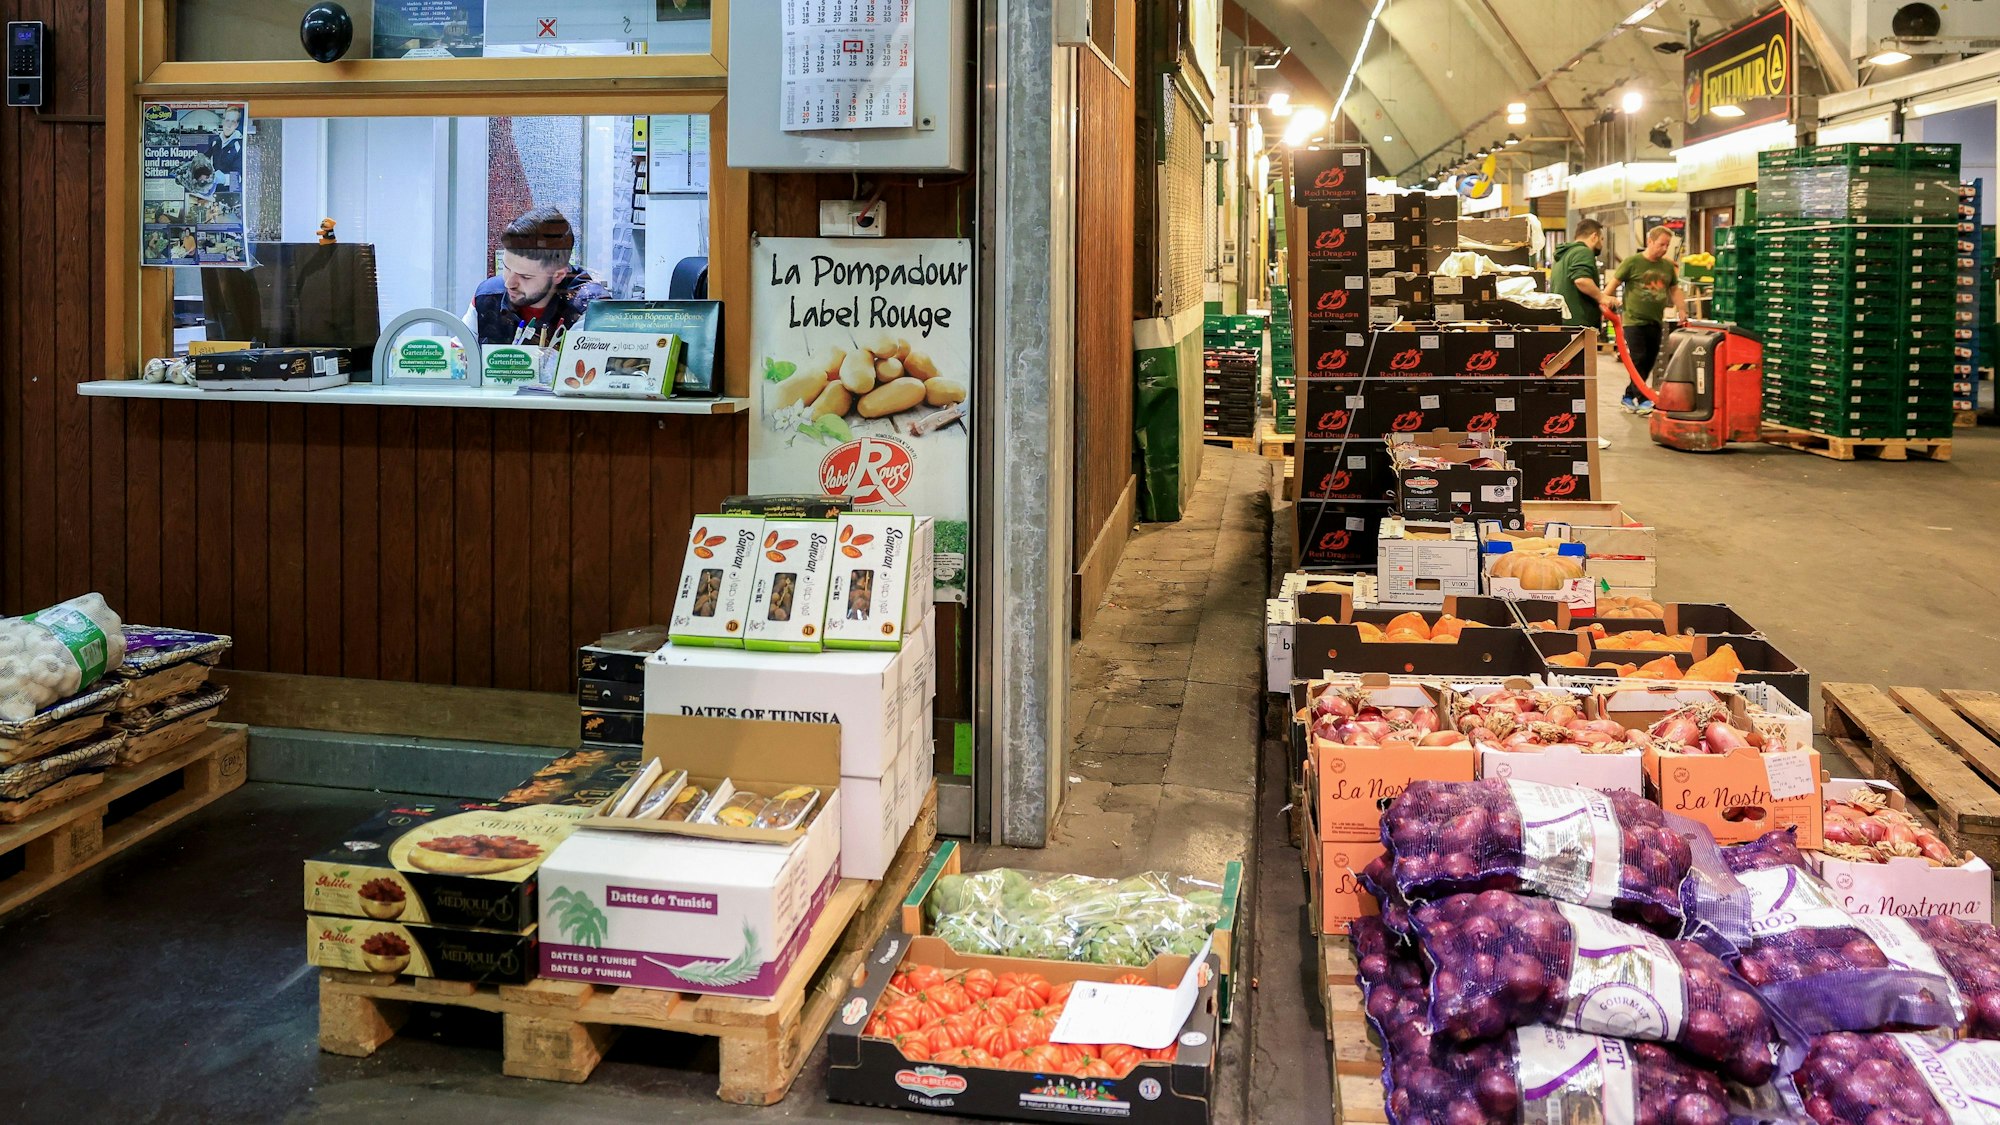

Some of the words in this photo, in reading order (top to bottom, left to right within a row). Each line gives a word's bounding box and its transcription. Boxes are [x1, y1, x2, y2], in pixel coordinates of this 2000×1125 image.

[1703, 43, 1766, 116] FRUTIMUR
[145, 148, 169, 158] Große
[170, 148, 198, 158] Klappe
[145, 158, 160, 166] und
[145, 168, 169, 177] Sitten
[771, 253, 800, 286] La
[810, 254, 968, 291] Pompadour
[644, 313, 673, 321] Βόρειας
[789, 296, 860, 328] Label
[870, 296, 951, 338] Rouge
[574, 336, 610, 351] Sanwan
[825, 462, 856, 489] label
[732, 529, 756, 569] Sanwan
[805, 532, 828, 573] Sanwan
[882, 527, 904, 569] Sanwan
[680, 705, 738, 718] DATES
[741, 707, 766, 721] OF
[768, 709, 841, 725] TUNISIA
[1332, 780, 1364, 800] La
[1368, 778, 1412, 799] Nost
[1676, 789, 1709, 810] La
[315, 888, 320, 896] 5
[610, 889, 649, 904] Dattes
[651, 894, 666, 906] de
[667, 894, 713, 909] Tunisie
[1878, 896, 1978, 917] Nostrana
[550, 951, 585, 962] DATTES
[586, 954, 598, 964] DE
[600, 955, 637, 967] TUNISIE
[550, 964, 580, 975] DATES
[581, 966, 593, 976] OF
[596, 968, 632, 979] TUNISIA
[1600, 996, 1651, 1021] GOURMET
